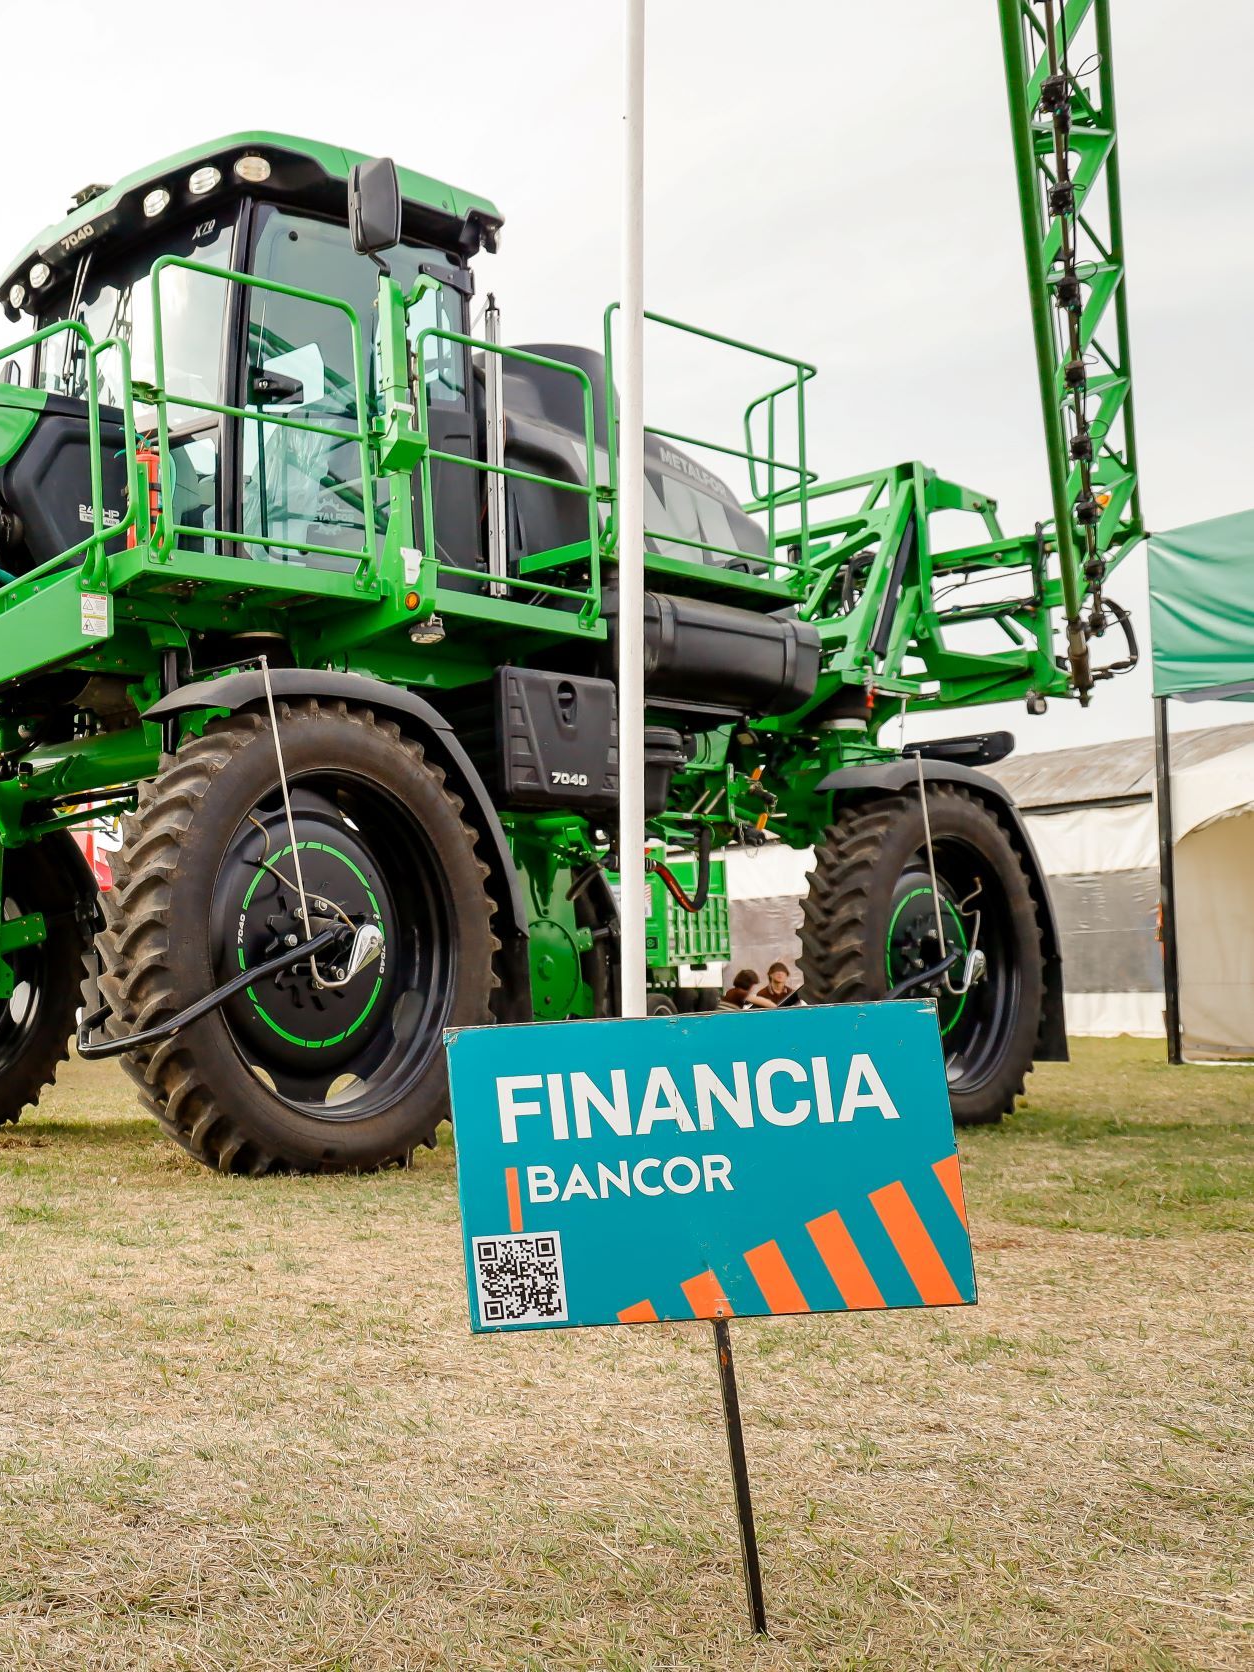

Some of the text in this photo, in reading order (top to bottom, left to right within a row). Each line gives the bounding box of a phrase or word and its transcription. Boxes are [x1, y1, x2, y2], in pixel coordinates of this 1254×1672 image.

[61, 224, 95, 250] 7040
[551, 771, 588, 786] 7040
[237, 913, 246, 945] 7040
[495, 1053, 901, 1144] FINANCIA
[526, 1154, 735, 1204] BANCOR
